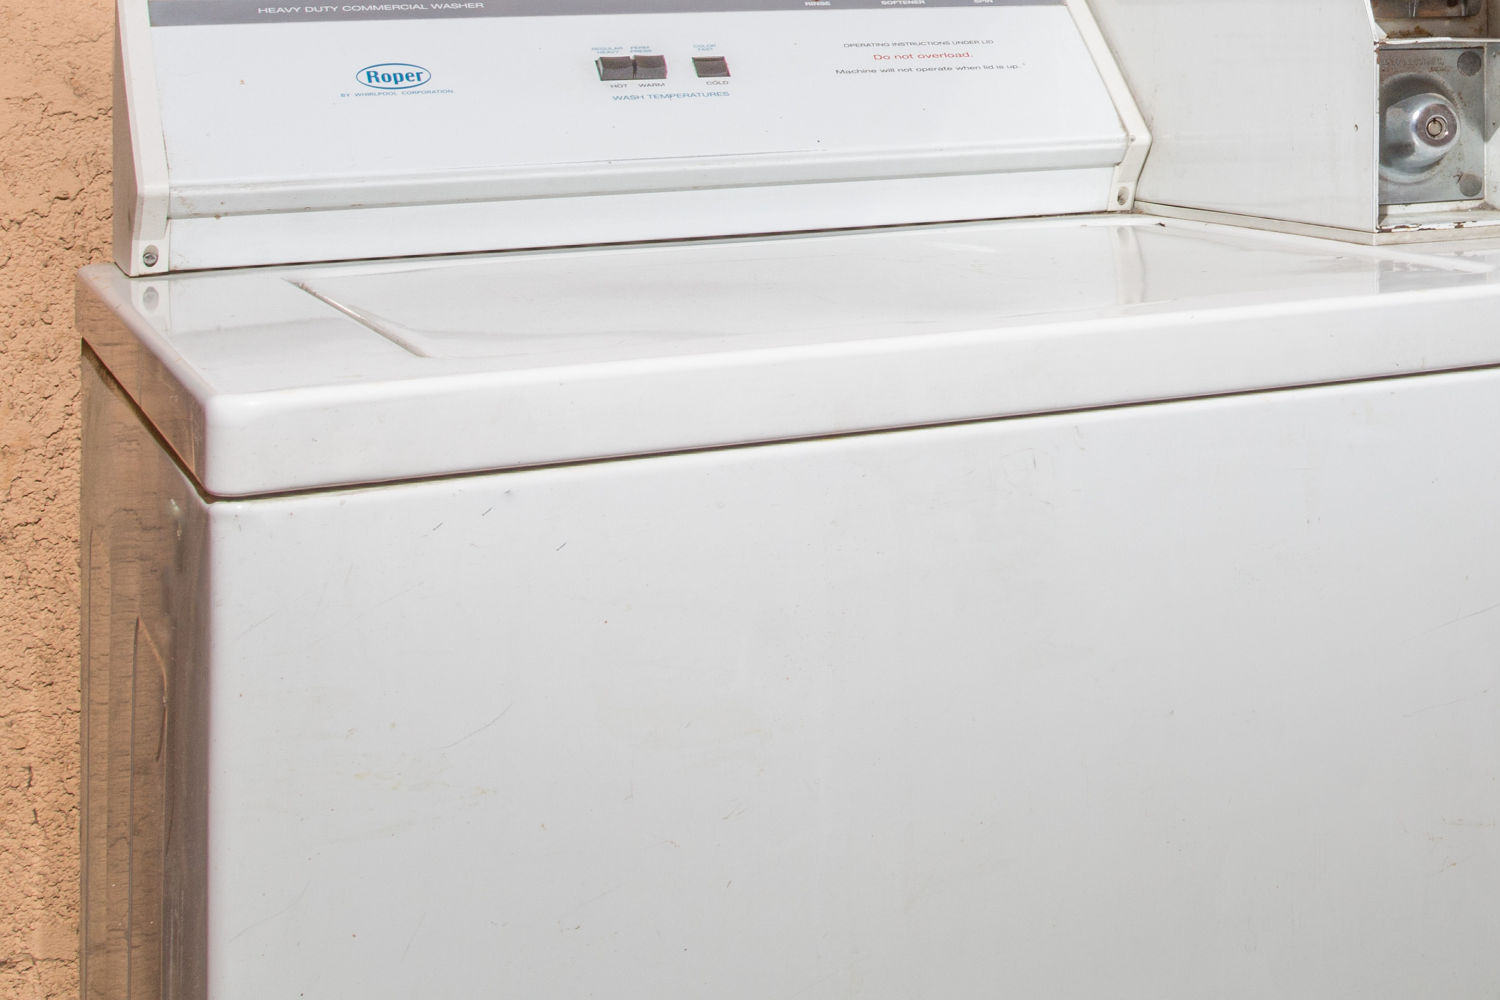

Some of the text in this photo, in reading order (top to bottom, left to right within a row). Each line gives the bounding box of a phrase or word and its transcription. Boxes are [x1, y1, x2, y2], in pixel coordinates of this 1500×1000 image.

[257, 7, 301, 15] HEAVY
[304, 5, 338, 13] DUTY
[342, 4, 428, 12] COMMERCIAL
[916, 66, 953, 74] operate
[366, 70, 424, 85] Roper
[649, 92, 730, 100] TEMPERATURES
